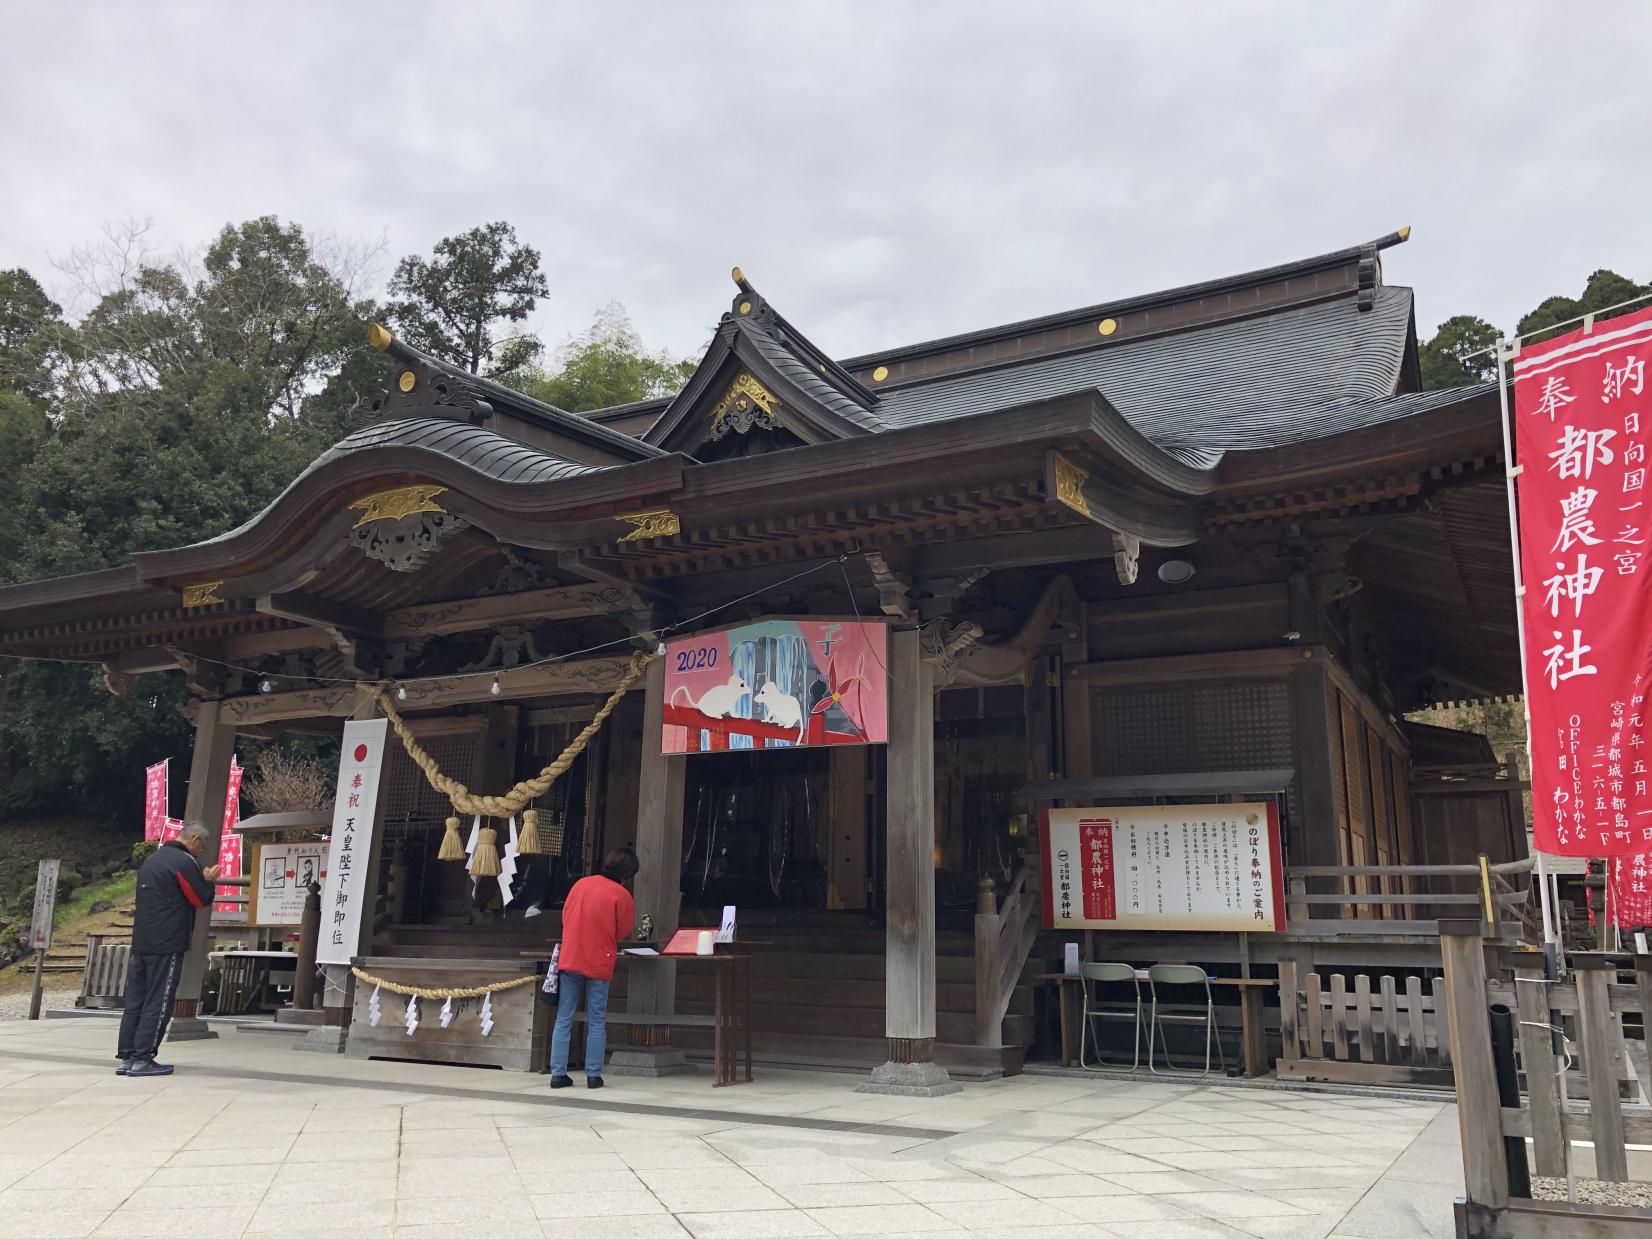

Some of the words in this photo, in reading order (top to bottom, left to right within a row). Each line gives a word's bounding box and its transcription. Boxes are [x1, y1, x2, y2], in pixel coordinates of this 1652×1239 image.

[1531, 356, 1646, 422] 奉納
[1612, 412, 1646, 575] 日向国一之宮
[1542, 425, 1617, 691] 都農神社
[676, 647, 718, 672] 2020
[815, 623, 846, 657] 子
[347, 773, 363, 809] 奉祝
[1607, 701, 1632, 845] 宮崎県都城市都島町
[1553, 786, 1570, 845] わかな
[332, 817, 356, 946] 天皇陛下御即位
[1090, 838, 1105, 890] 都農神社
[1248, 828, 1264, 920] のぼり奉納のご案内
[1061, 882, 1072, 919] 都農神社
